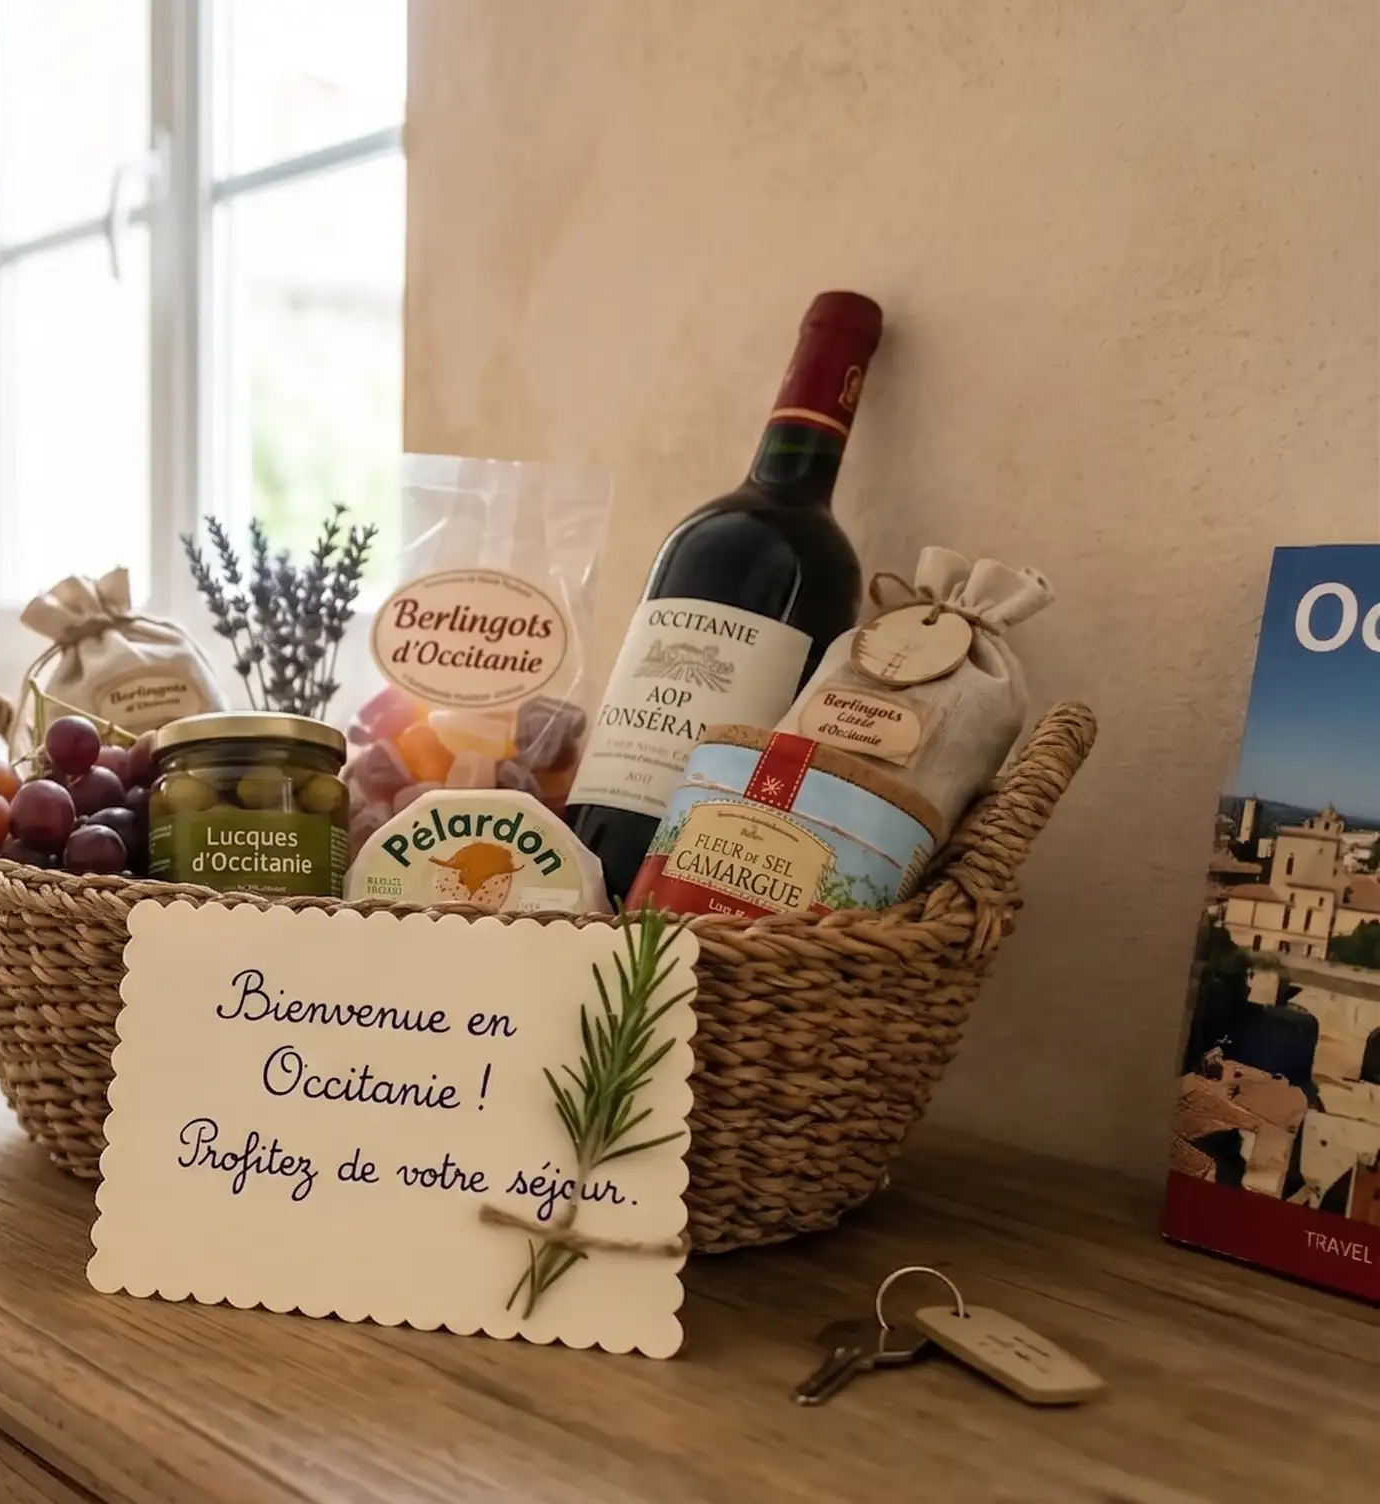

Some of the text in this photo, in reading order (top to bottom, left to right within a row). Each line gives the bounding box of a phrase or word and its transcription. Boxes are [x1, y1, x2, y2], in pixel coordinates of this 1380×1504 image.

[394, 599, 553, 643] Berlingots
[649, 610, 759, 646] OCCITANIE
[391, 640, 543, 674] d'Occitanie
[646, 686, 693, 708] AOP
[823, 693, 902, 722] Berlingots
[207, 826, 299, 850] Lucques
[381, 808, 562, 877] Pélardon
[694, 833, 744, 860] FLEUR
[763, 855, 793, 878] SEL
[192, 852, 313, 874] d'Occitanie
[676, 850, 802, 908] CAMARGUE
[216, 969, 518, 1037] Bienvenue en
[263, 1045, 492, 1110] Occitanie !
[178, 1118, 319, 1202] Profitez
[337, 1148, 380, 1183] de
[396, 1153, 489, 1193] votre
[1304, 1230, 1372, 1265] TRAVEL
